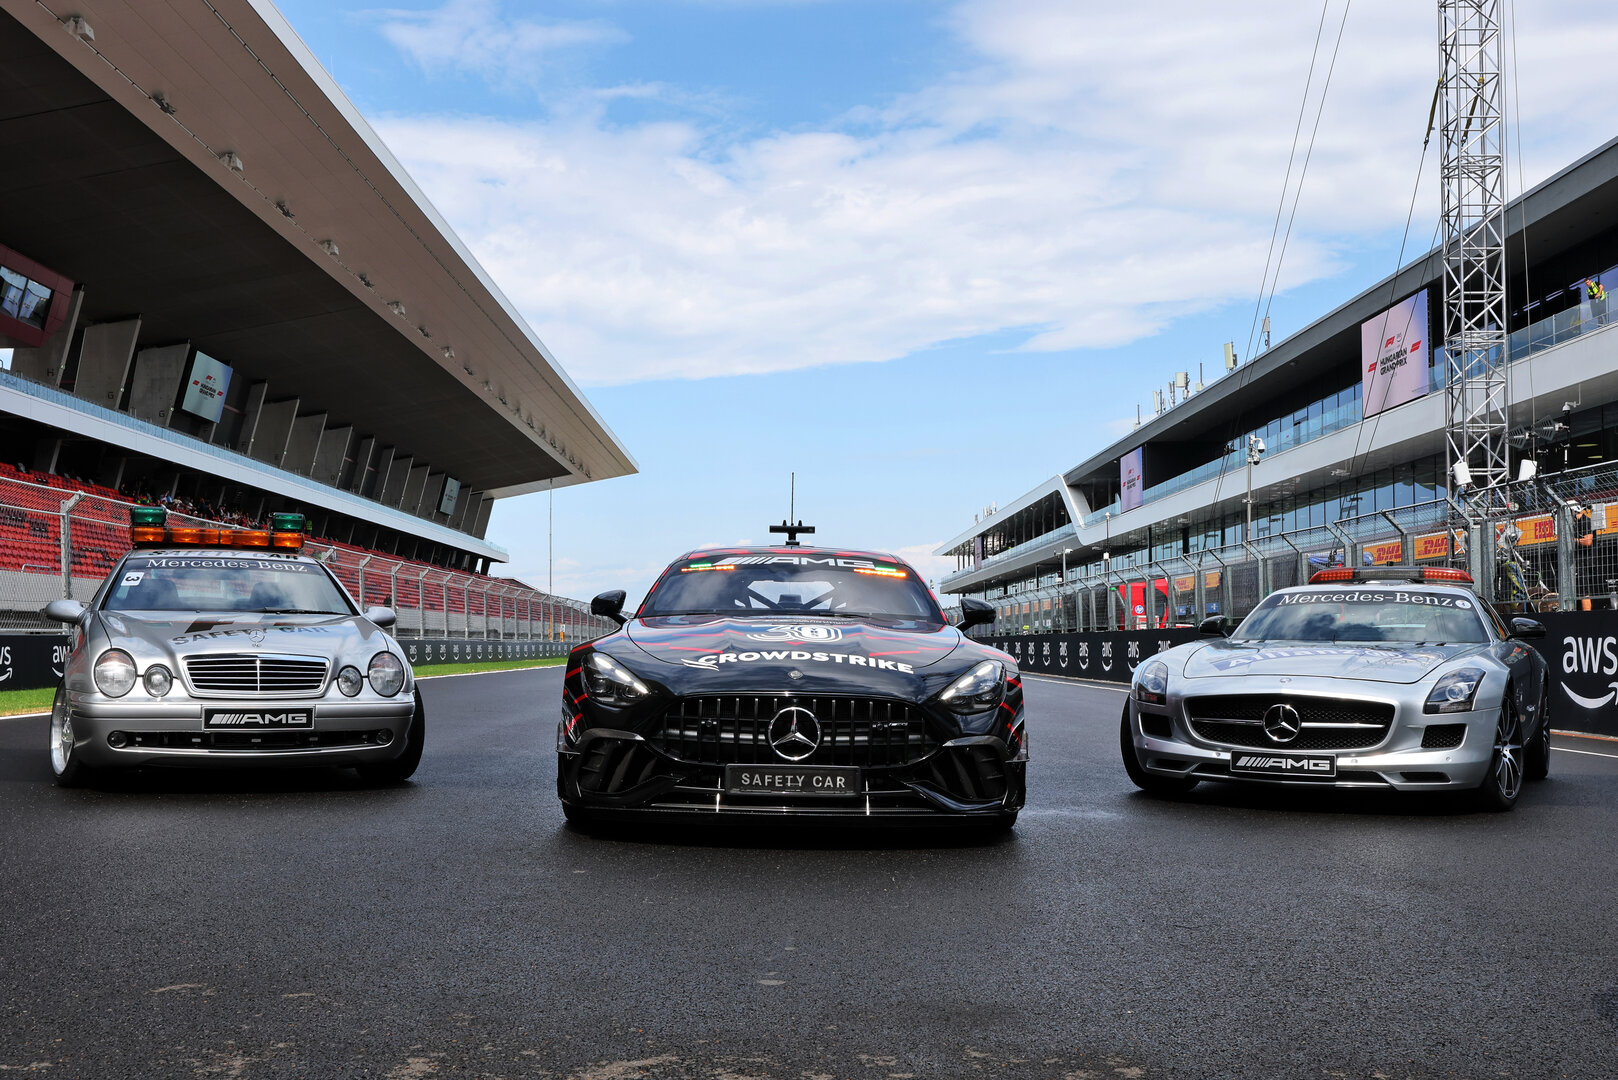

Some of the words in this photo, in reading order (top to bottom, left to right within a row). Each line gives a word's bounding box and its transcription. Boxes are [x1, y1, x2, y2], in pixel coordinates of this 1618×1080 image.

[1380, 347, 1408, 366] HUNGARIAN
[1380, 362, 1396, 376] GRAND
[1395, 356, 1408, 368] PRIX
[146, 559, 308, 573] Mercedes-Benz
[764, 557, 876, 569] AMG
[1277, 592, 1453, 607] Mercedes-Benz
[699, 651, 915, 674] CROWDSTRIKE
[1563, 636, 1618, 676] aws
[240, 713, 307, 725] AMG
[1264, 758, 1330, 771] AMG
[741, 773, 805, 788] SAFETY
[812, 775, 846, 788] CAR
